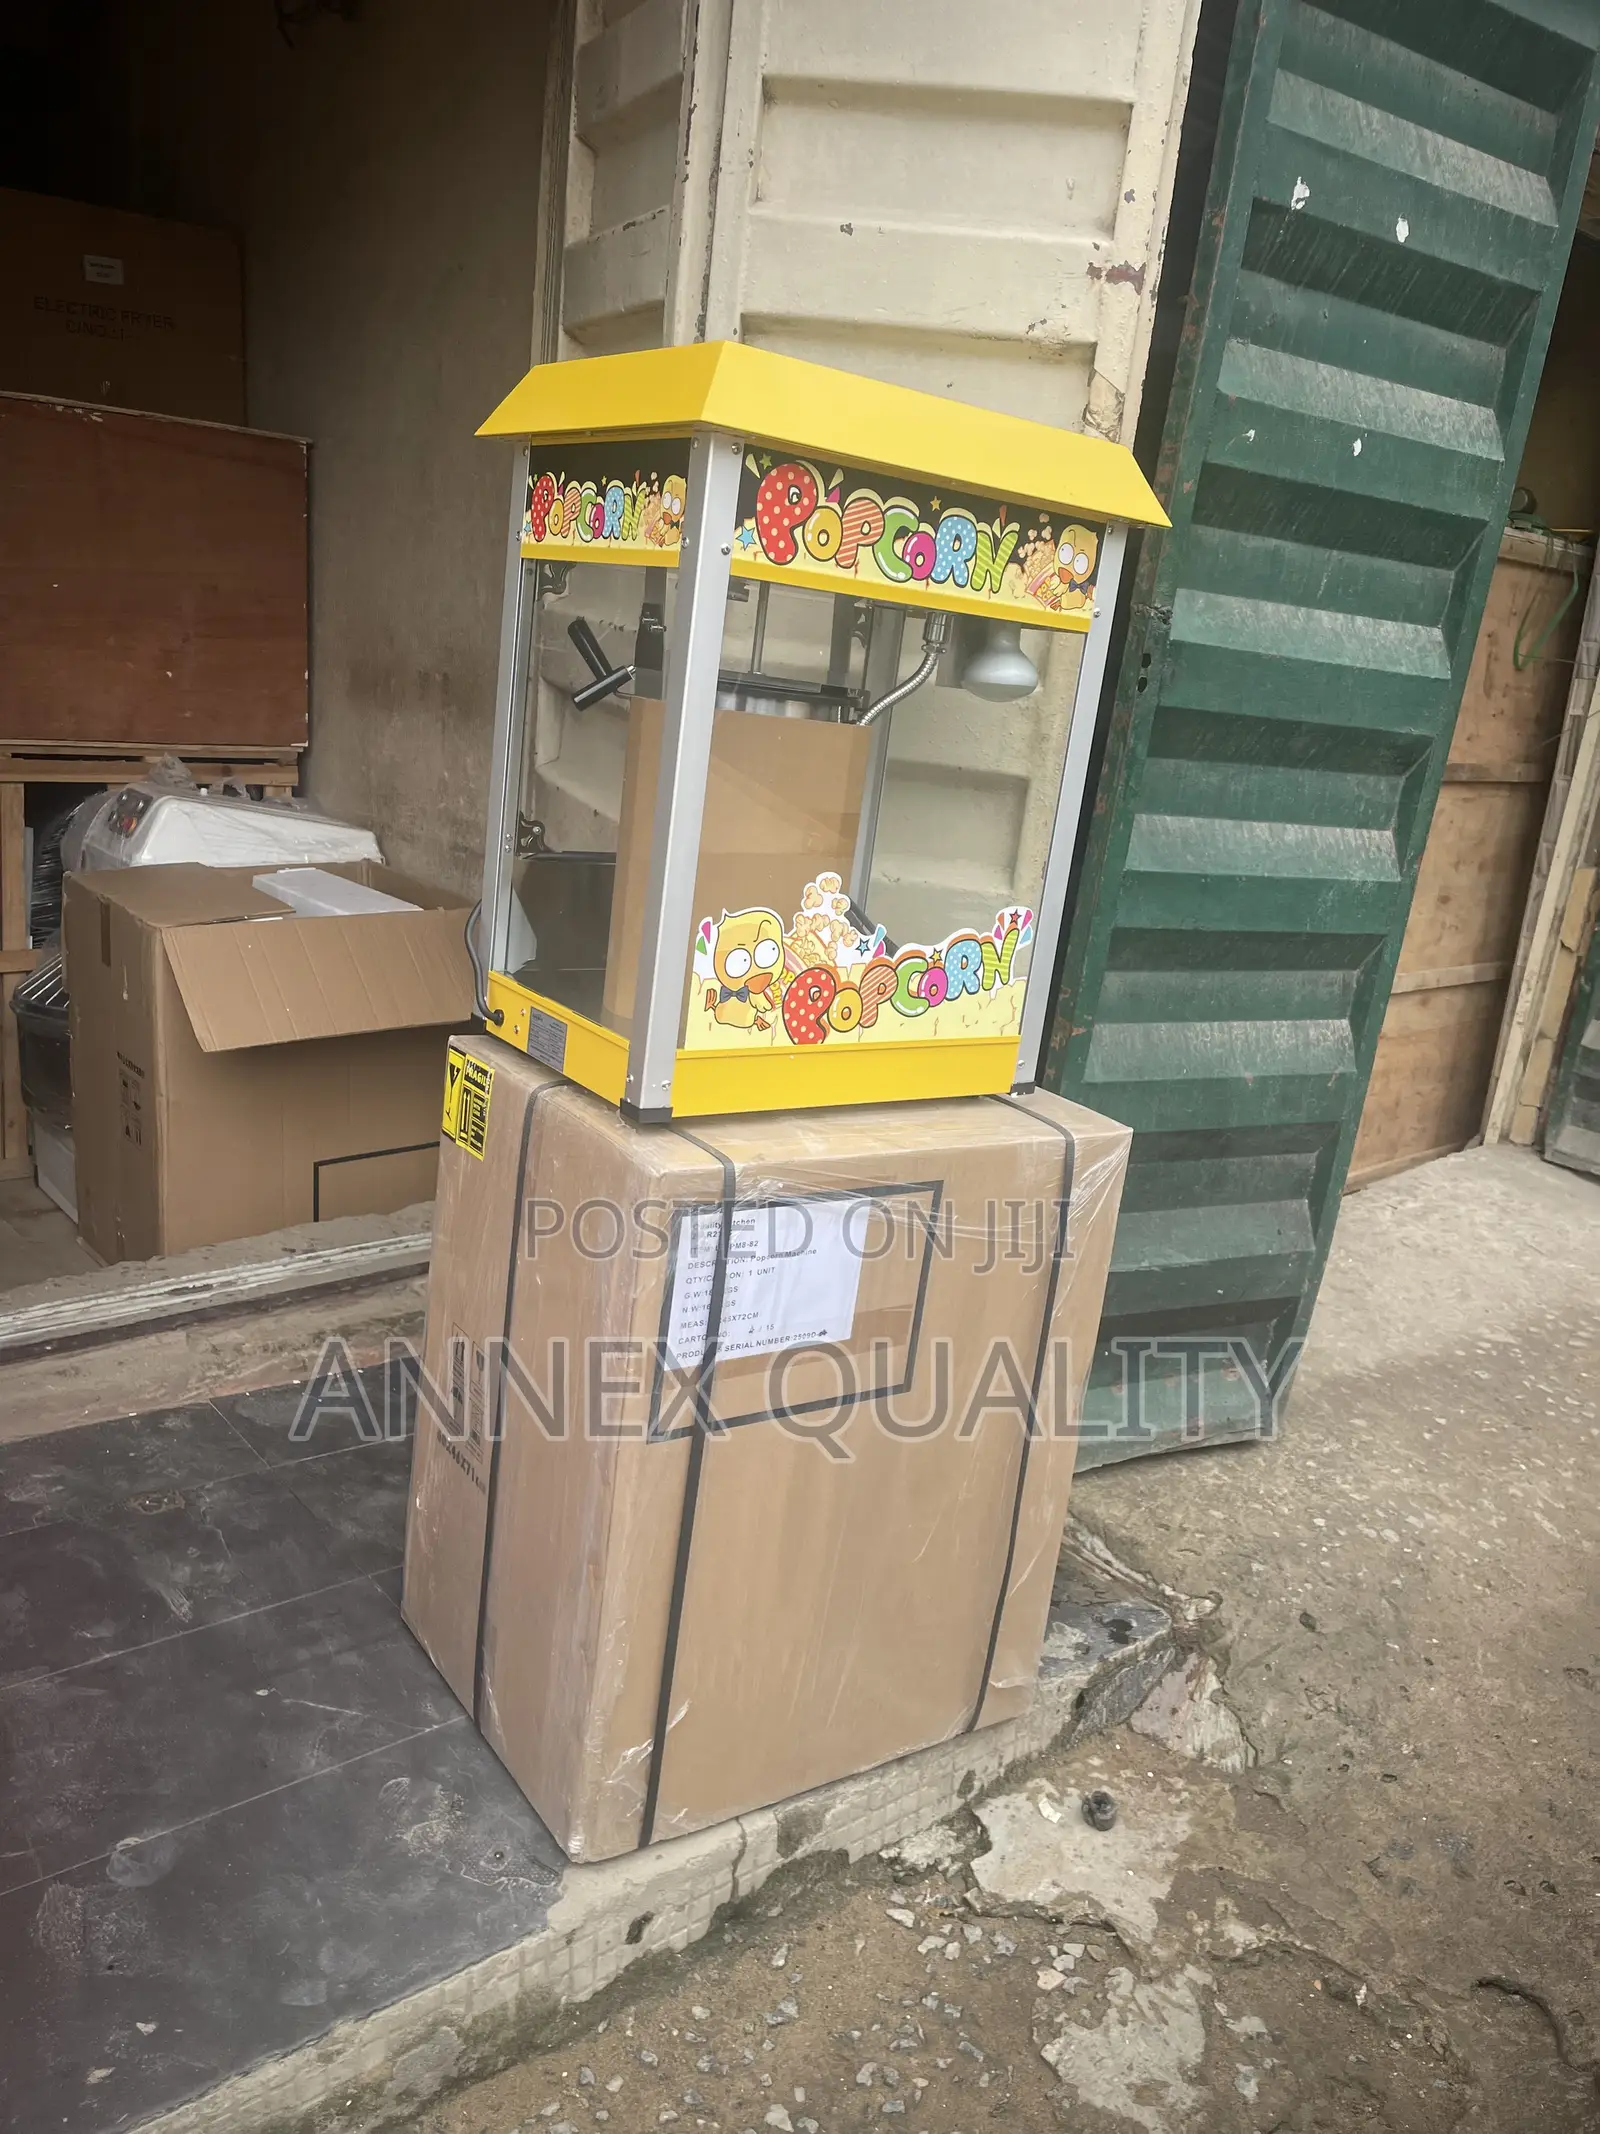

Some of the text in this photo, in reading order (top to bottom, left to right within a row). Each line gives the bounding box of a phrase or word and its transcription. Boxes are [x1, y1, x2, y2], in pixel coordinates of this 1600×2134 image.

[33, 295, 117, 321] ELECTRIC
[531, 473, 647, 543] POPCORN
[755, 460, 1020, 594] POPCORN
[782, 926, 1021, 1045] POPCORN
[750, 1251, 785, 1263] Popcorn
[784, 1248, 817, 1259] Machine
[757, 1266, 776, 1276] UNIT
[766, 1324, 775, 1332] 15
[724, 1341, 754, 1353] SERIAL
